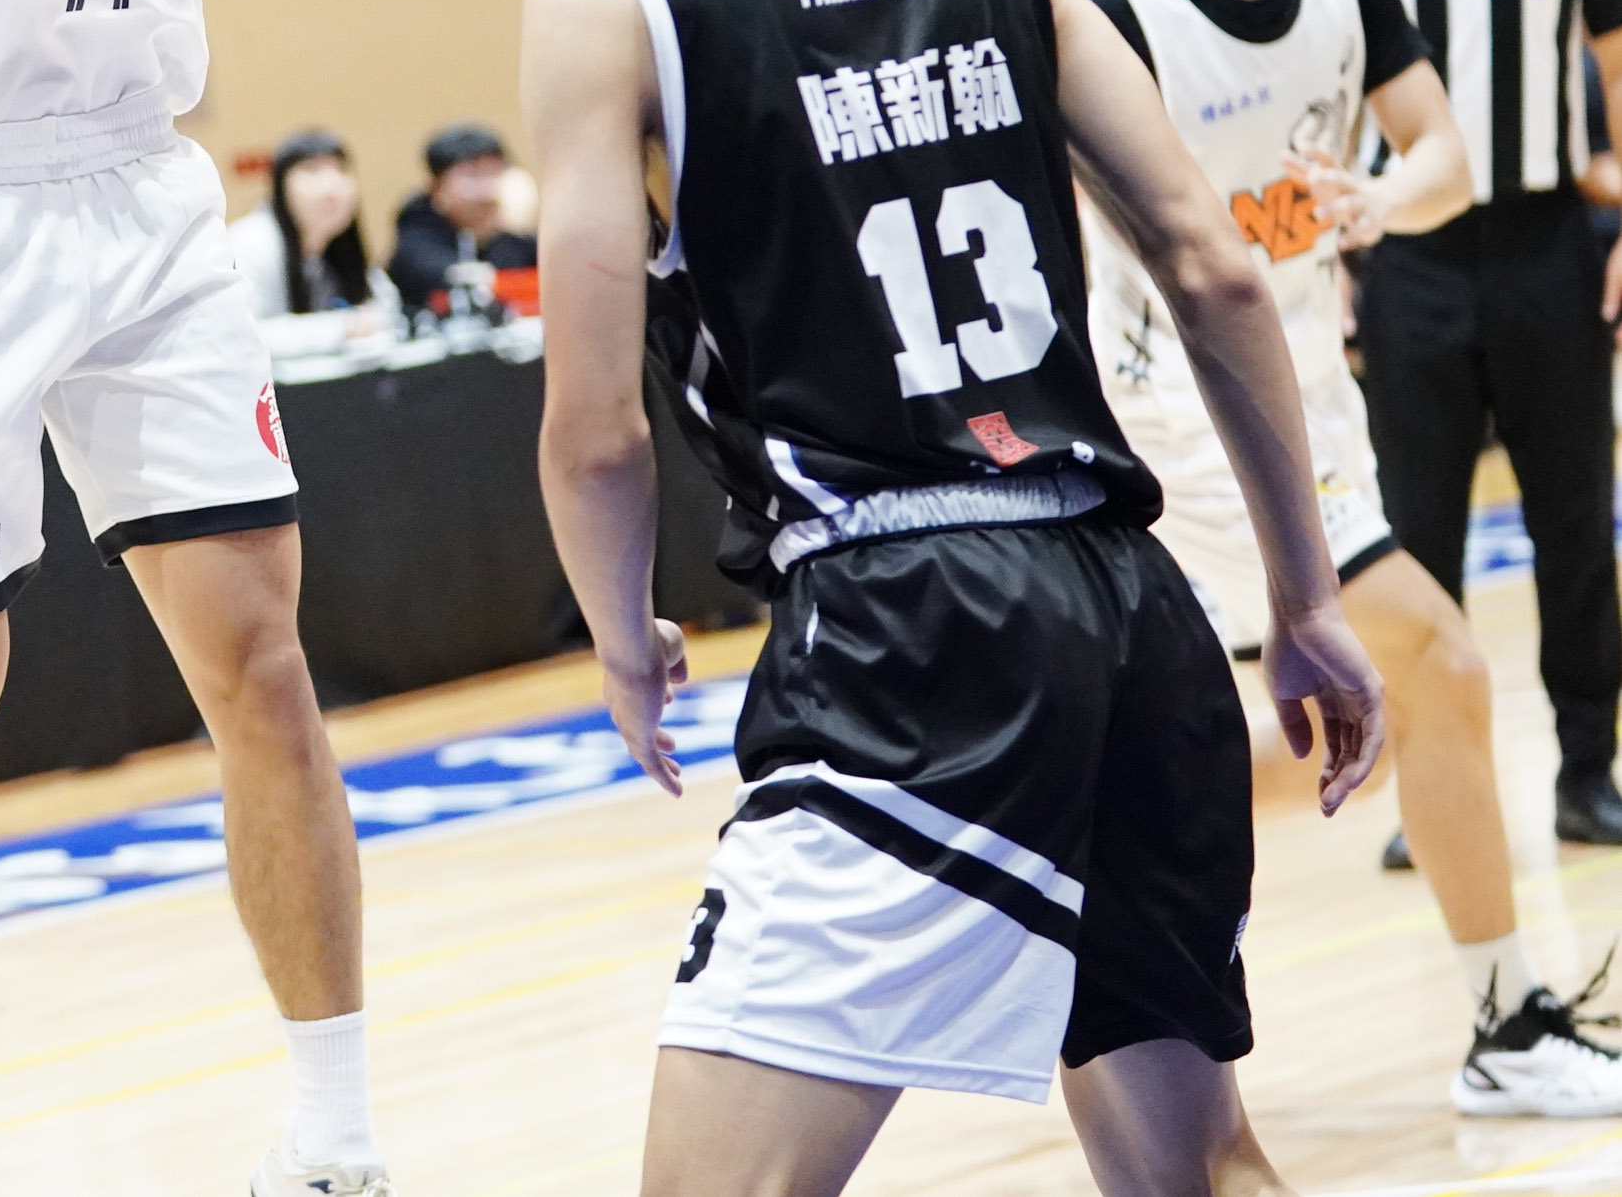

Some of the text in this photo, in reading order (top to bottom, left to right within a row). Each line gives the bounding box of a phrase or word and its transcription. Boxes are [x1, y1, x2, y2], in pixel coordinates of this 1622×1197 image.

[796, 37, 1023, 166] 陳新翰
[856, 178, 1059, 399] 13
